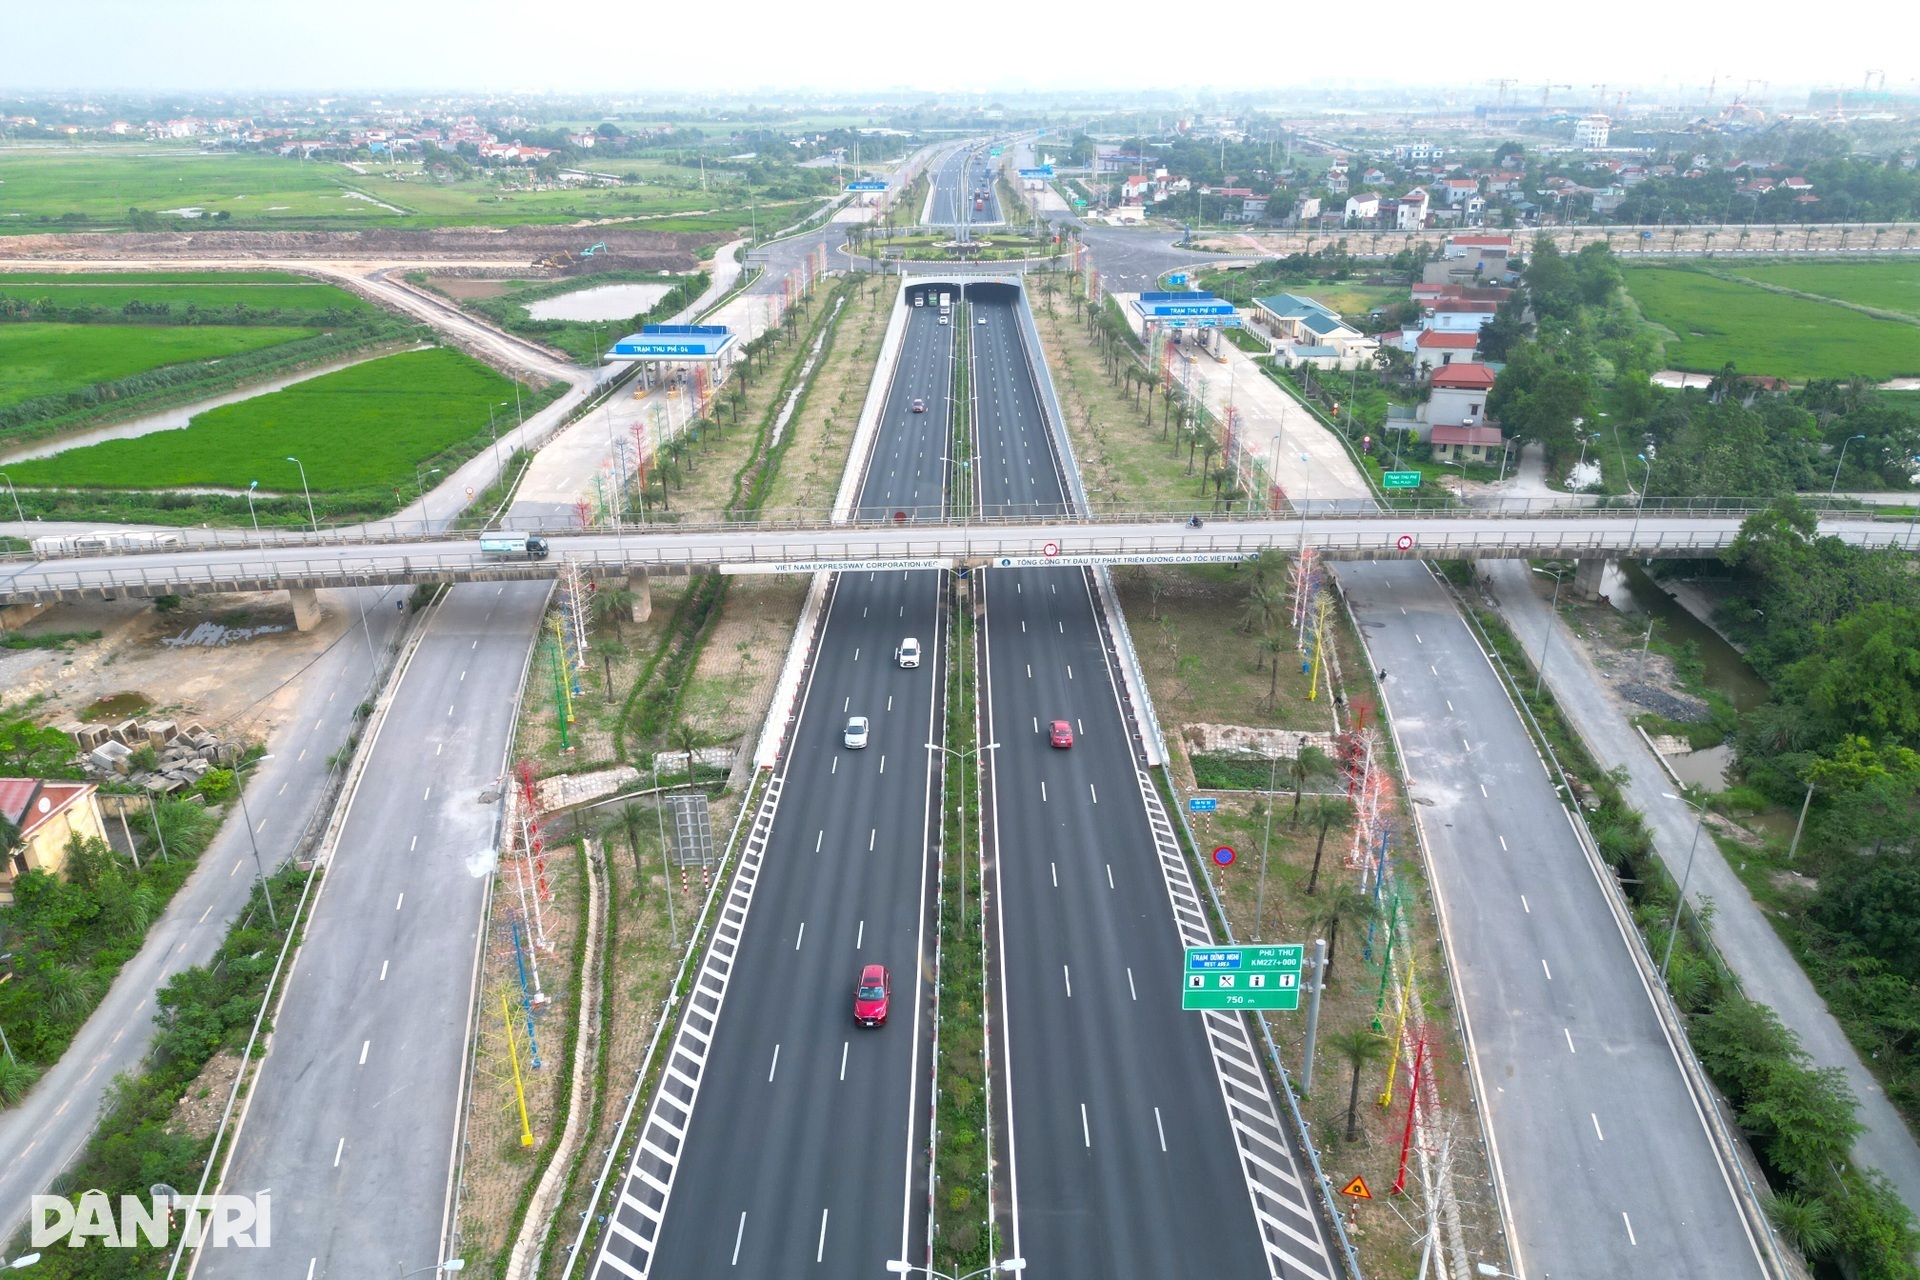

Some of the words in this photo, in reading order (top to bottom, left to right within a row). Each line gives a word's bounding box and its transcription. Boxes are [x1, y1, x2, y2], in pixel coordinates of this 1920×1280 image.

[1039, 557, 1060, 566] CÔNG
[1176, 555, 1191, 563] CAO
[1228, 554, 1244, 562] NAM
[813, 562, 864, 570] EXPRESSWAY
[1251, 958, 1297, 966] KM227+000
[1226, 996, 1244, 1004] 750
